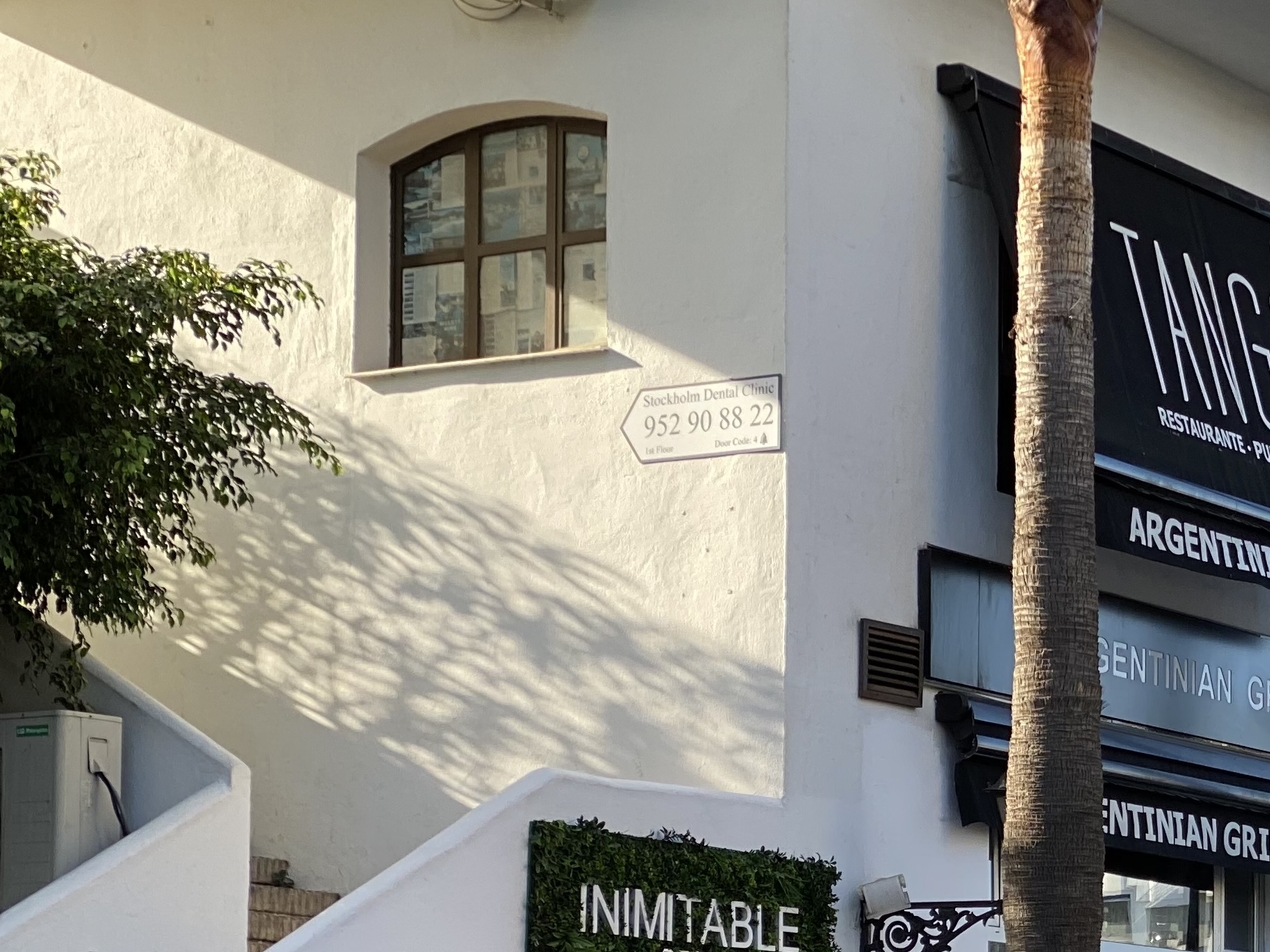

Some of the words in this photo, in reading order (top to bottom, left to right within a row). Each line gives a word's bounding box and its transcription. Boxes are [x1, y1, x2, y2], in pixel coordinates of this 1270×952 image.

[643, 391, 700, 408] Stockholm
[703, 387, 739, 402] Dental
[742, 381, 775, 397] Clinic
[644, 413, 681, 438] 952
[688, 409, 712, 434] 90
[719, 406, 743, 430] 88
[750, 403, 774, 427] 22
[1157, 406, 1246, 454] RESTAURANTE
[656, 445, 674, 455] Floor
[715, 439, 732, 448] Door
